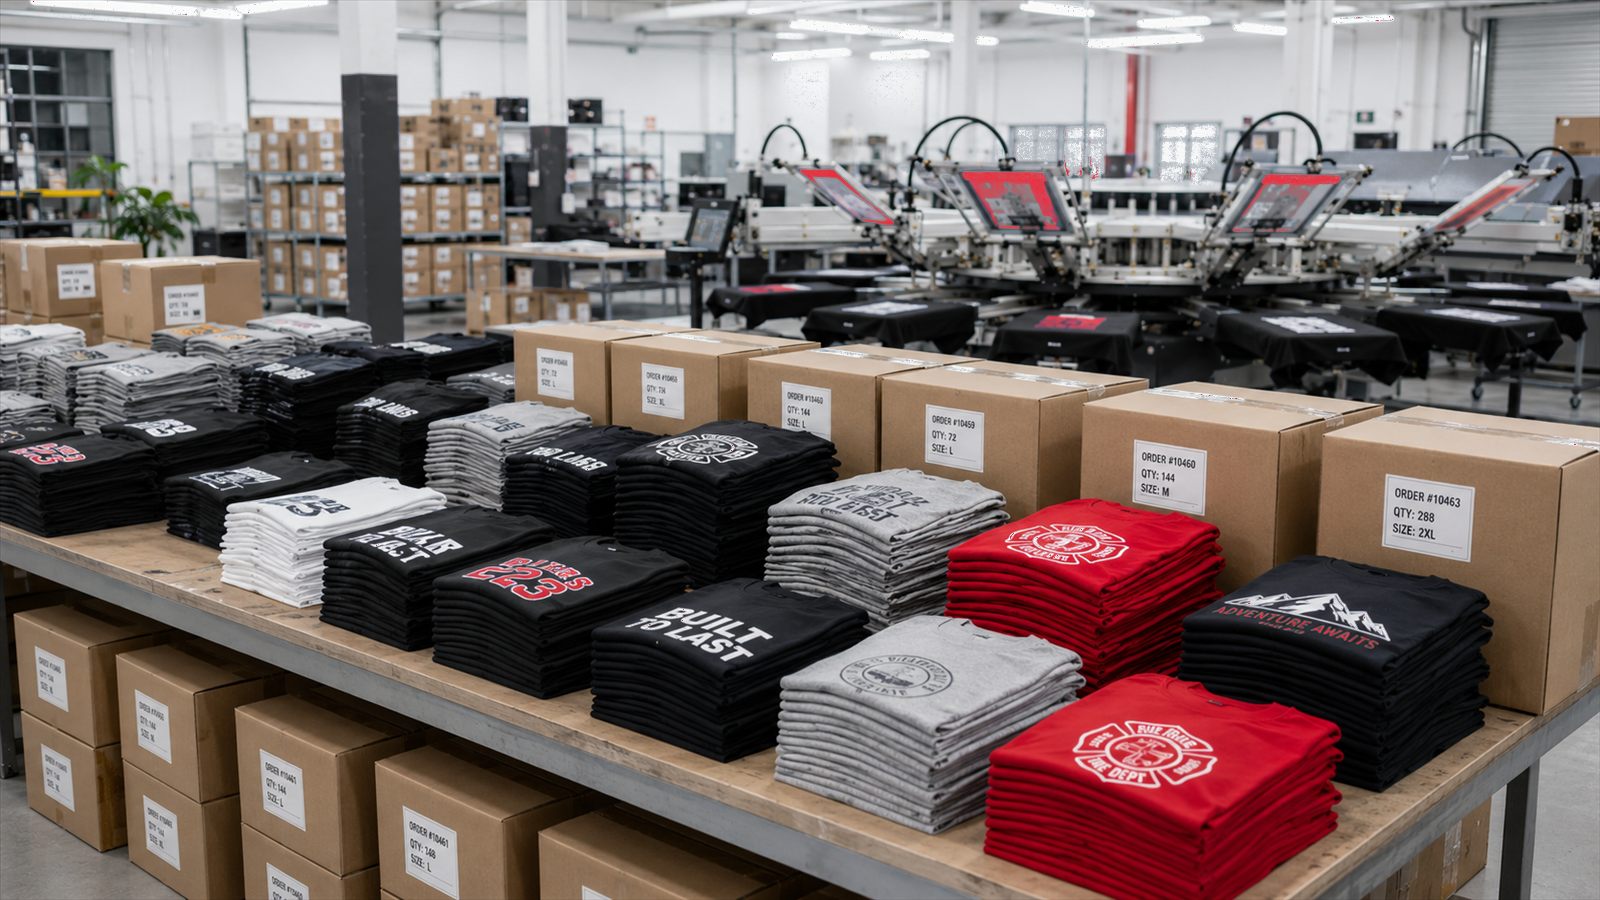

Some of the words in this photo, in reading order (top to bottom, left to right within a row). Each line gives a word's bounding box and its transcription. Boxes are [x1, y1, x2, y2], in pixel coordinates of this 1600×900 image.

[787, 392, 804, 402] ORDER
[787, 405, 800, 415] QTY:
[787, 418, 800, 428] SIZE:
[802, 420, 806, 428] L
[932, 414, 952, 426] ORDER
[932, 430, 946, 440] QTY:
[948, 433, 957, 442] 72
[932, 443, 948, 454] SIZE:
[950, 446, 954, 455] L
[1142, 452, 1166, 464] ORDER
[1168, 456, 1196, 469] #10460
[1141, 468, 1159, 480] QTY:
[1162, 472, 1175, 482] 144
[1140, 483, 1160, 495] SIZE:
[1162, 487, 1170, 496] M
[1394, 488, 1424, 502] ORDER
[1427, 494, 1461, 508] #10463
[1394, 506, 1414, 520] QTY:
[1418, 510, 1435, 523] 288
[1392, 523, 1416, 536] SIZE:
[1418, 528, 1436, 540] 2XL
[462, 566, 568, 600] 223
[654, 607, 773, 644] BUILT
[1214, 606, 1312, 630] ADVENTURE
[1311, 625, 1379, 650] AWAITS
[624, 618, 672, 630] TO
[664, 626, 754, 662] LAST
[265, 762, 280, 776] ORDER
[1108, 768, 1147, 784] DEPT
[266, 778, 278, 790] QTY:
[267, 791, 278, 804] SIZE:
[280, 798, 284, 808] L
[409, 821, 428, 838] ORDER
[410, 838, 424, 853] QTY:
[410, 853, 424, 868] SIZE:
[427, 862, 432, 872] L
